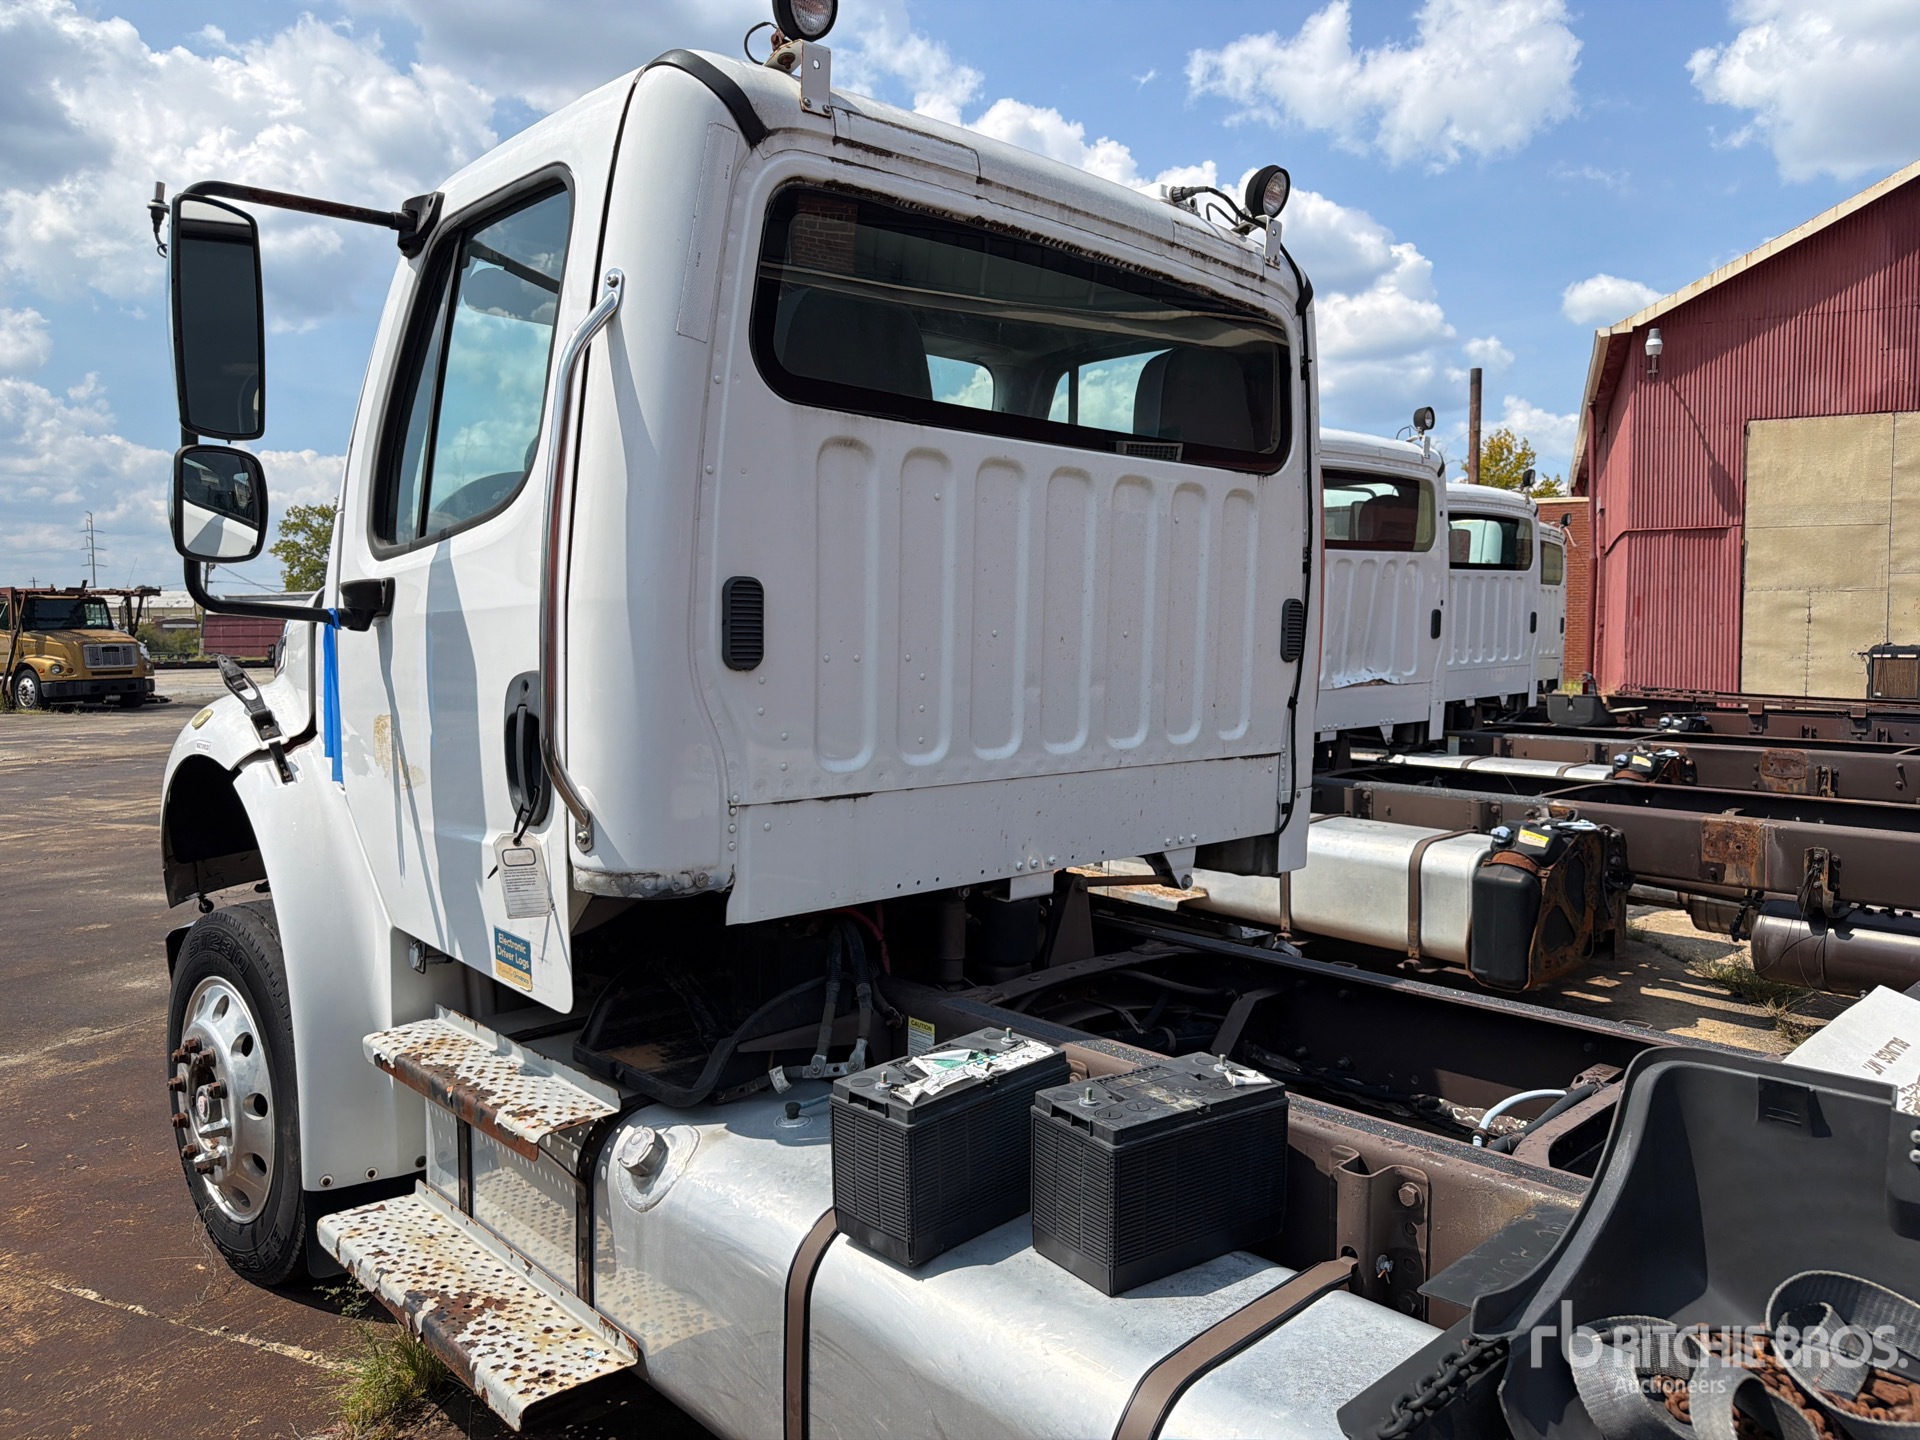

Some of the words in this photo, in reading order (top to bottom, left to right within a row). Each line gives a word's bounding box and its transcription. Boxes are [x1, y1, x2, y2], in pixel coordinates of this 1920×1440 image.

[498, 933, 527, 954] Electronic
[497, 945, 515, 961] Driver
[515, 953, 530, 970] Logs
[911, 1019, 933, 1032] CAUTION
